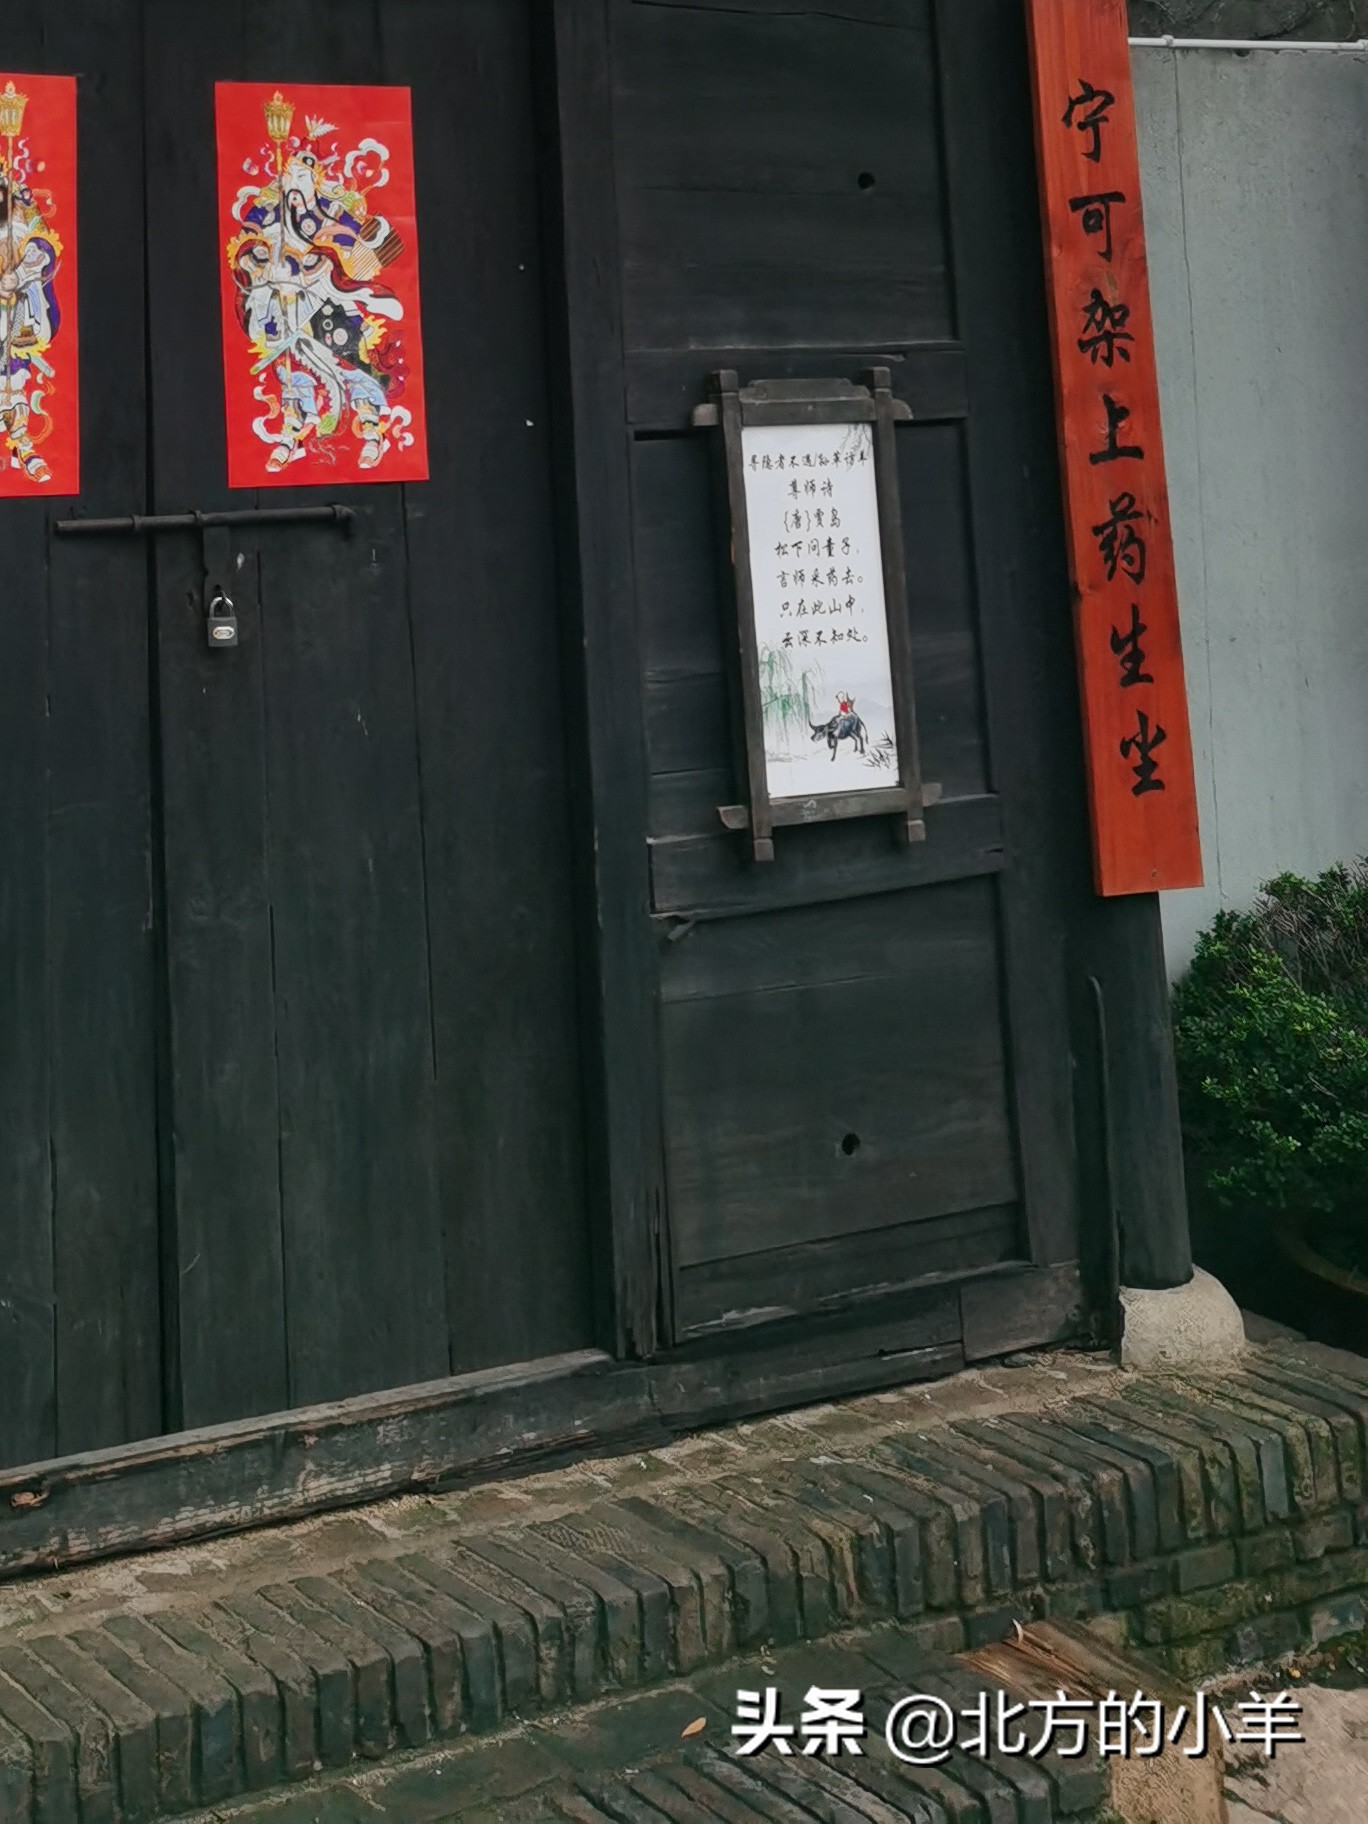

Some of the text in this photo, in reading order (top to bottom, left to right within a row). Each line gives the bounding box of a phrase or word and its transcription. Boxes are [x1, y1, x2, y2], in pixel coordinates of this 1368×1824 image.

[1061, 78, 1168, 798] 宁可架上药生尘
